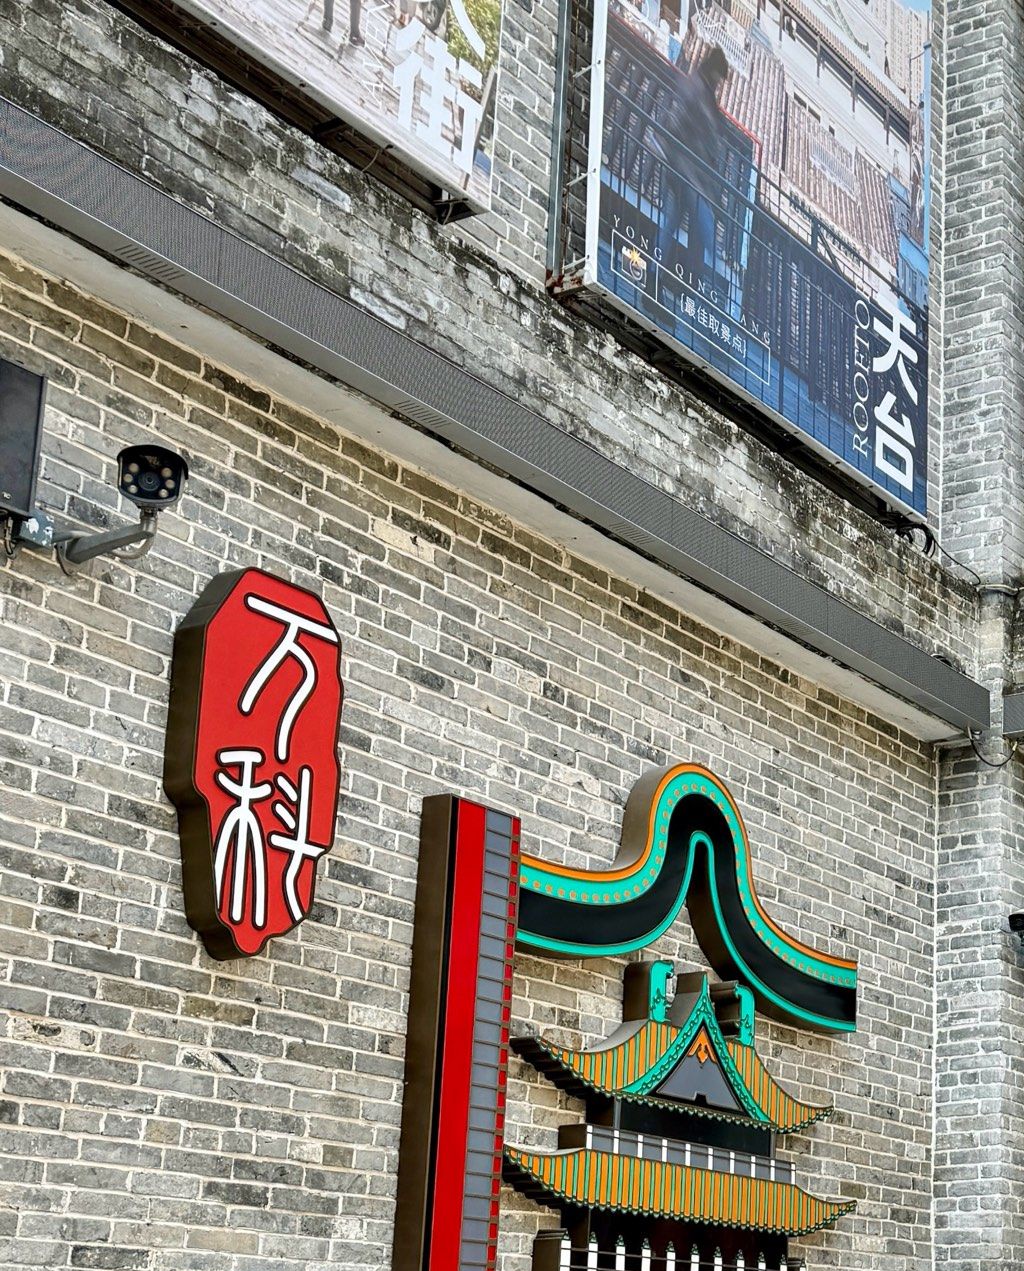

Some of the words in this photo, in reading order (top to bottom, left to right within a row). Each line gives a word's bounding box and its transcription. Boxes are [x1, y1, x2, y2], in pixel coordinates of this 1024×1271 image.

[393, 0, 486, 174] 街
[613, 214, 662, 261] YONG
[675, 263, 718, 303] QING
[873, 286, 918, 492] 天台
